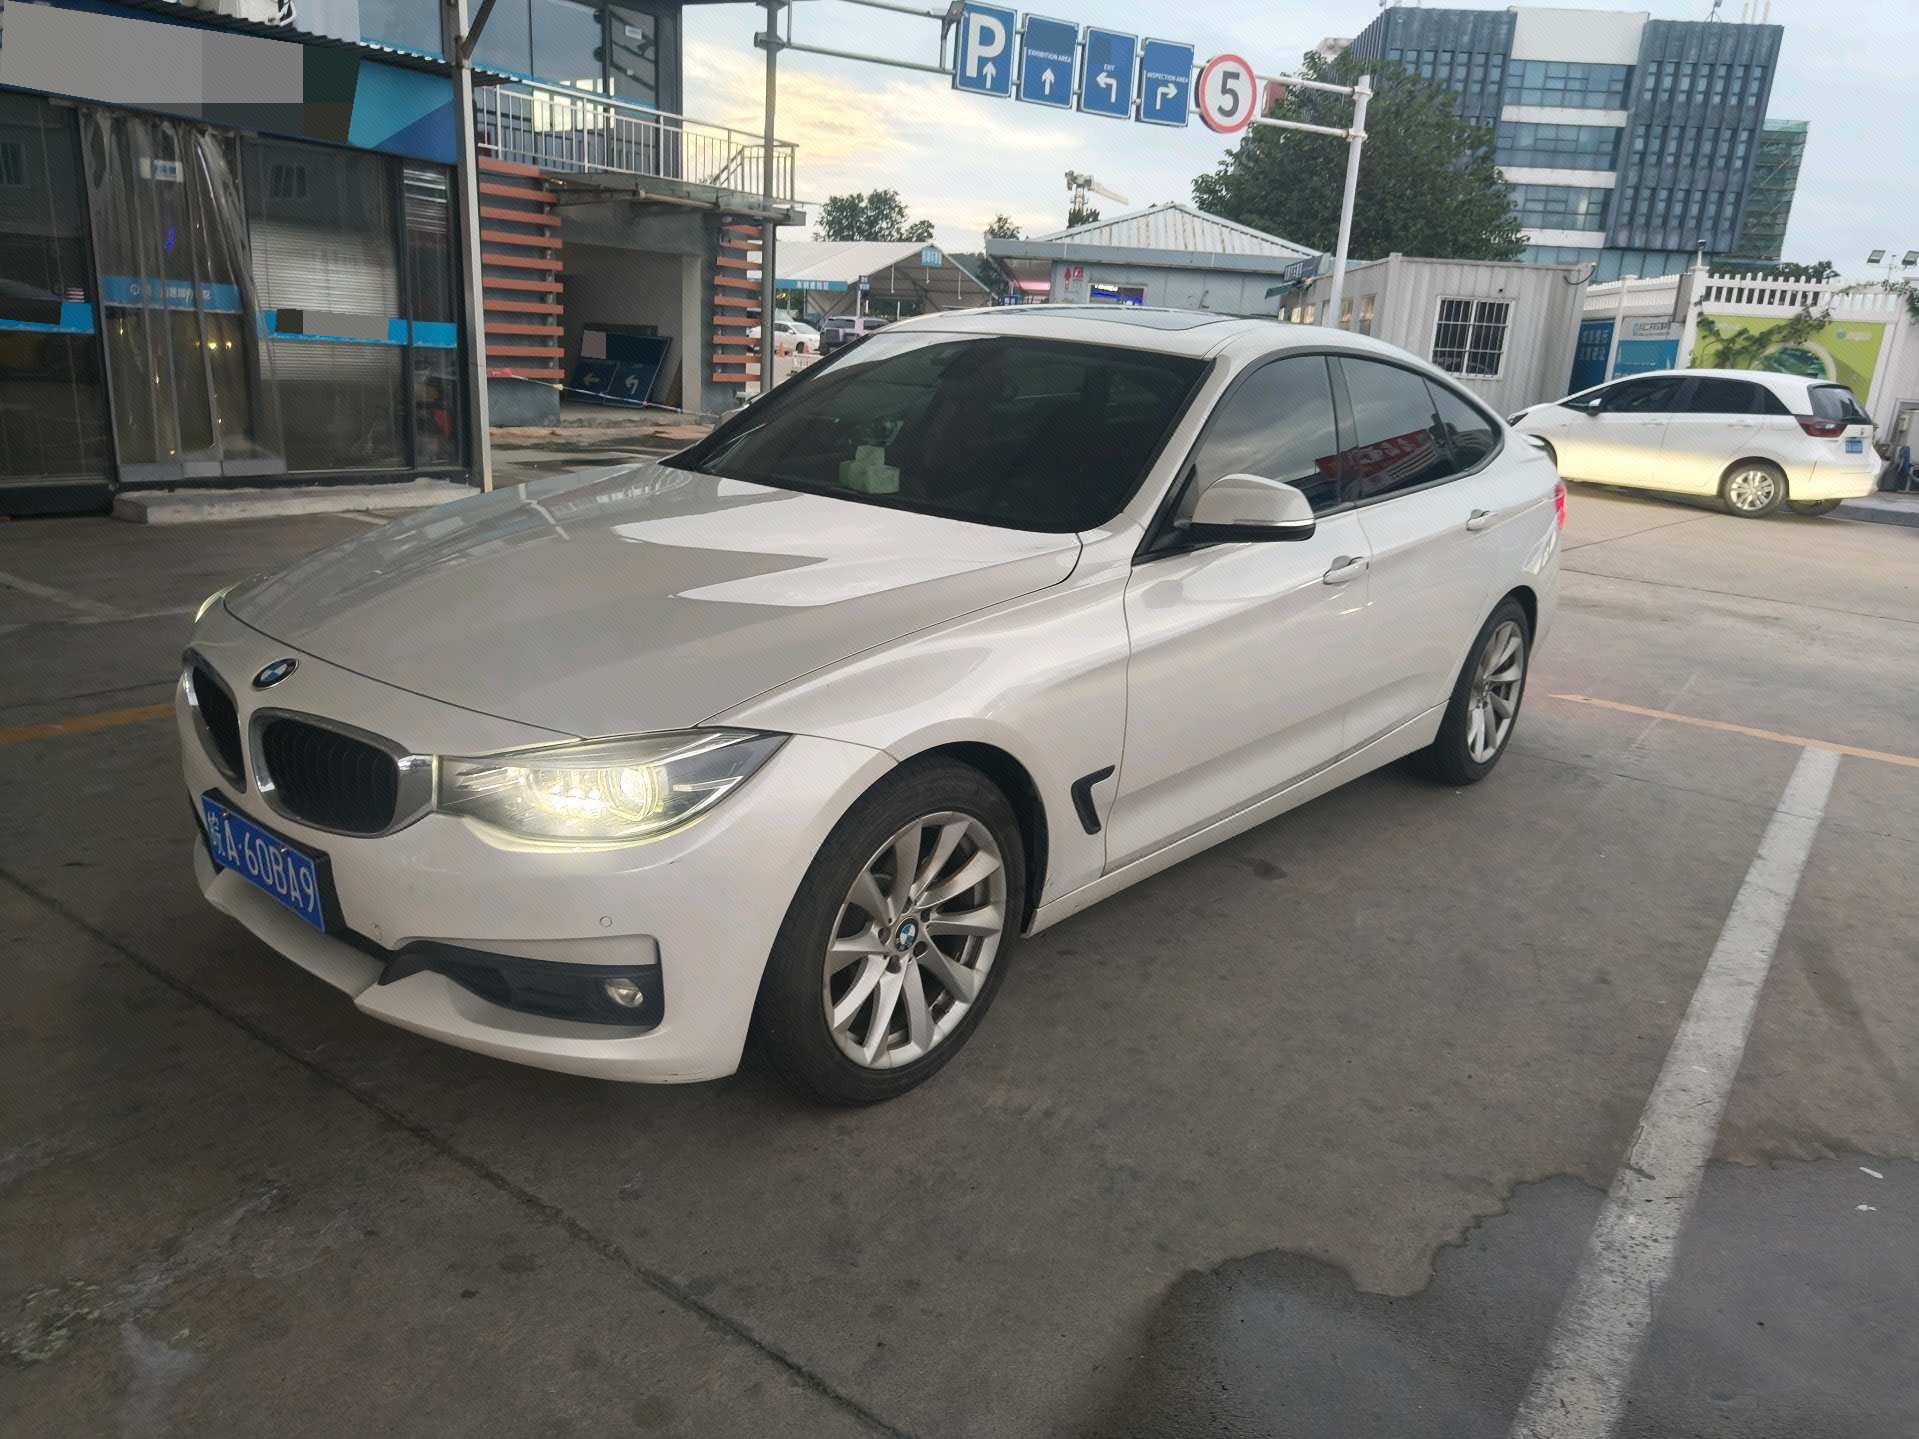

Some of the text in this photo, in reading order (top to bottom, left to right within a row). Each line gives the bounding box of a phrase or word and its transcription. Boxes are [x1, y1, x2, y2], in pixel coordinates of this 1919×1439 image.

[966, 12, 1006, 78] P
[1057, 55, 1072, 64] AREA
[1217, 70, 1240, 117] 5
